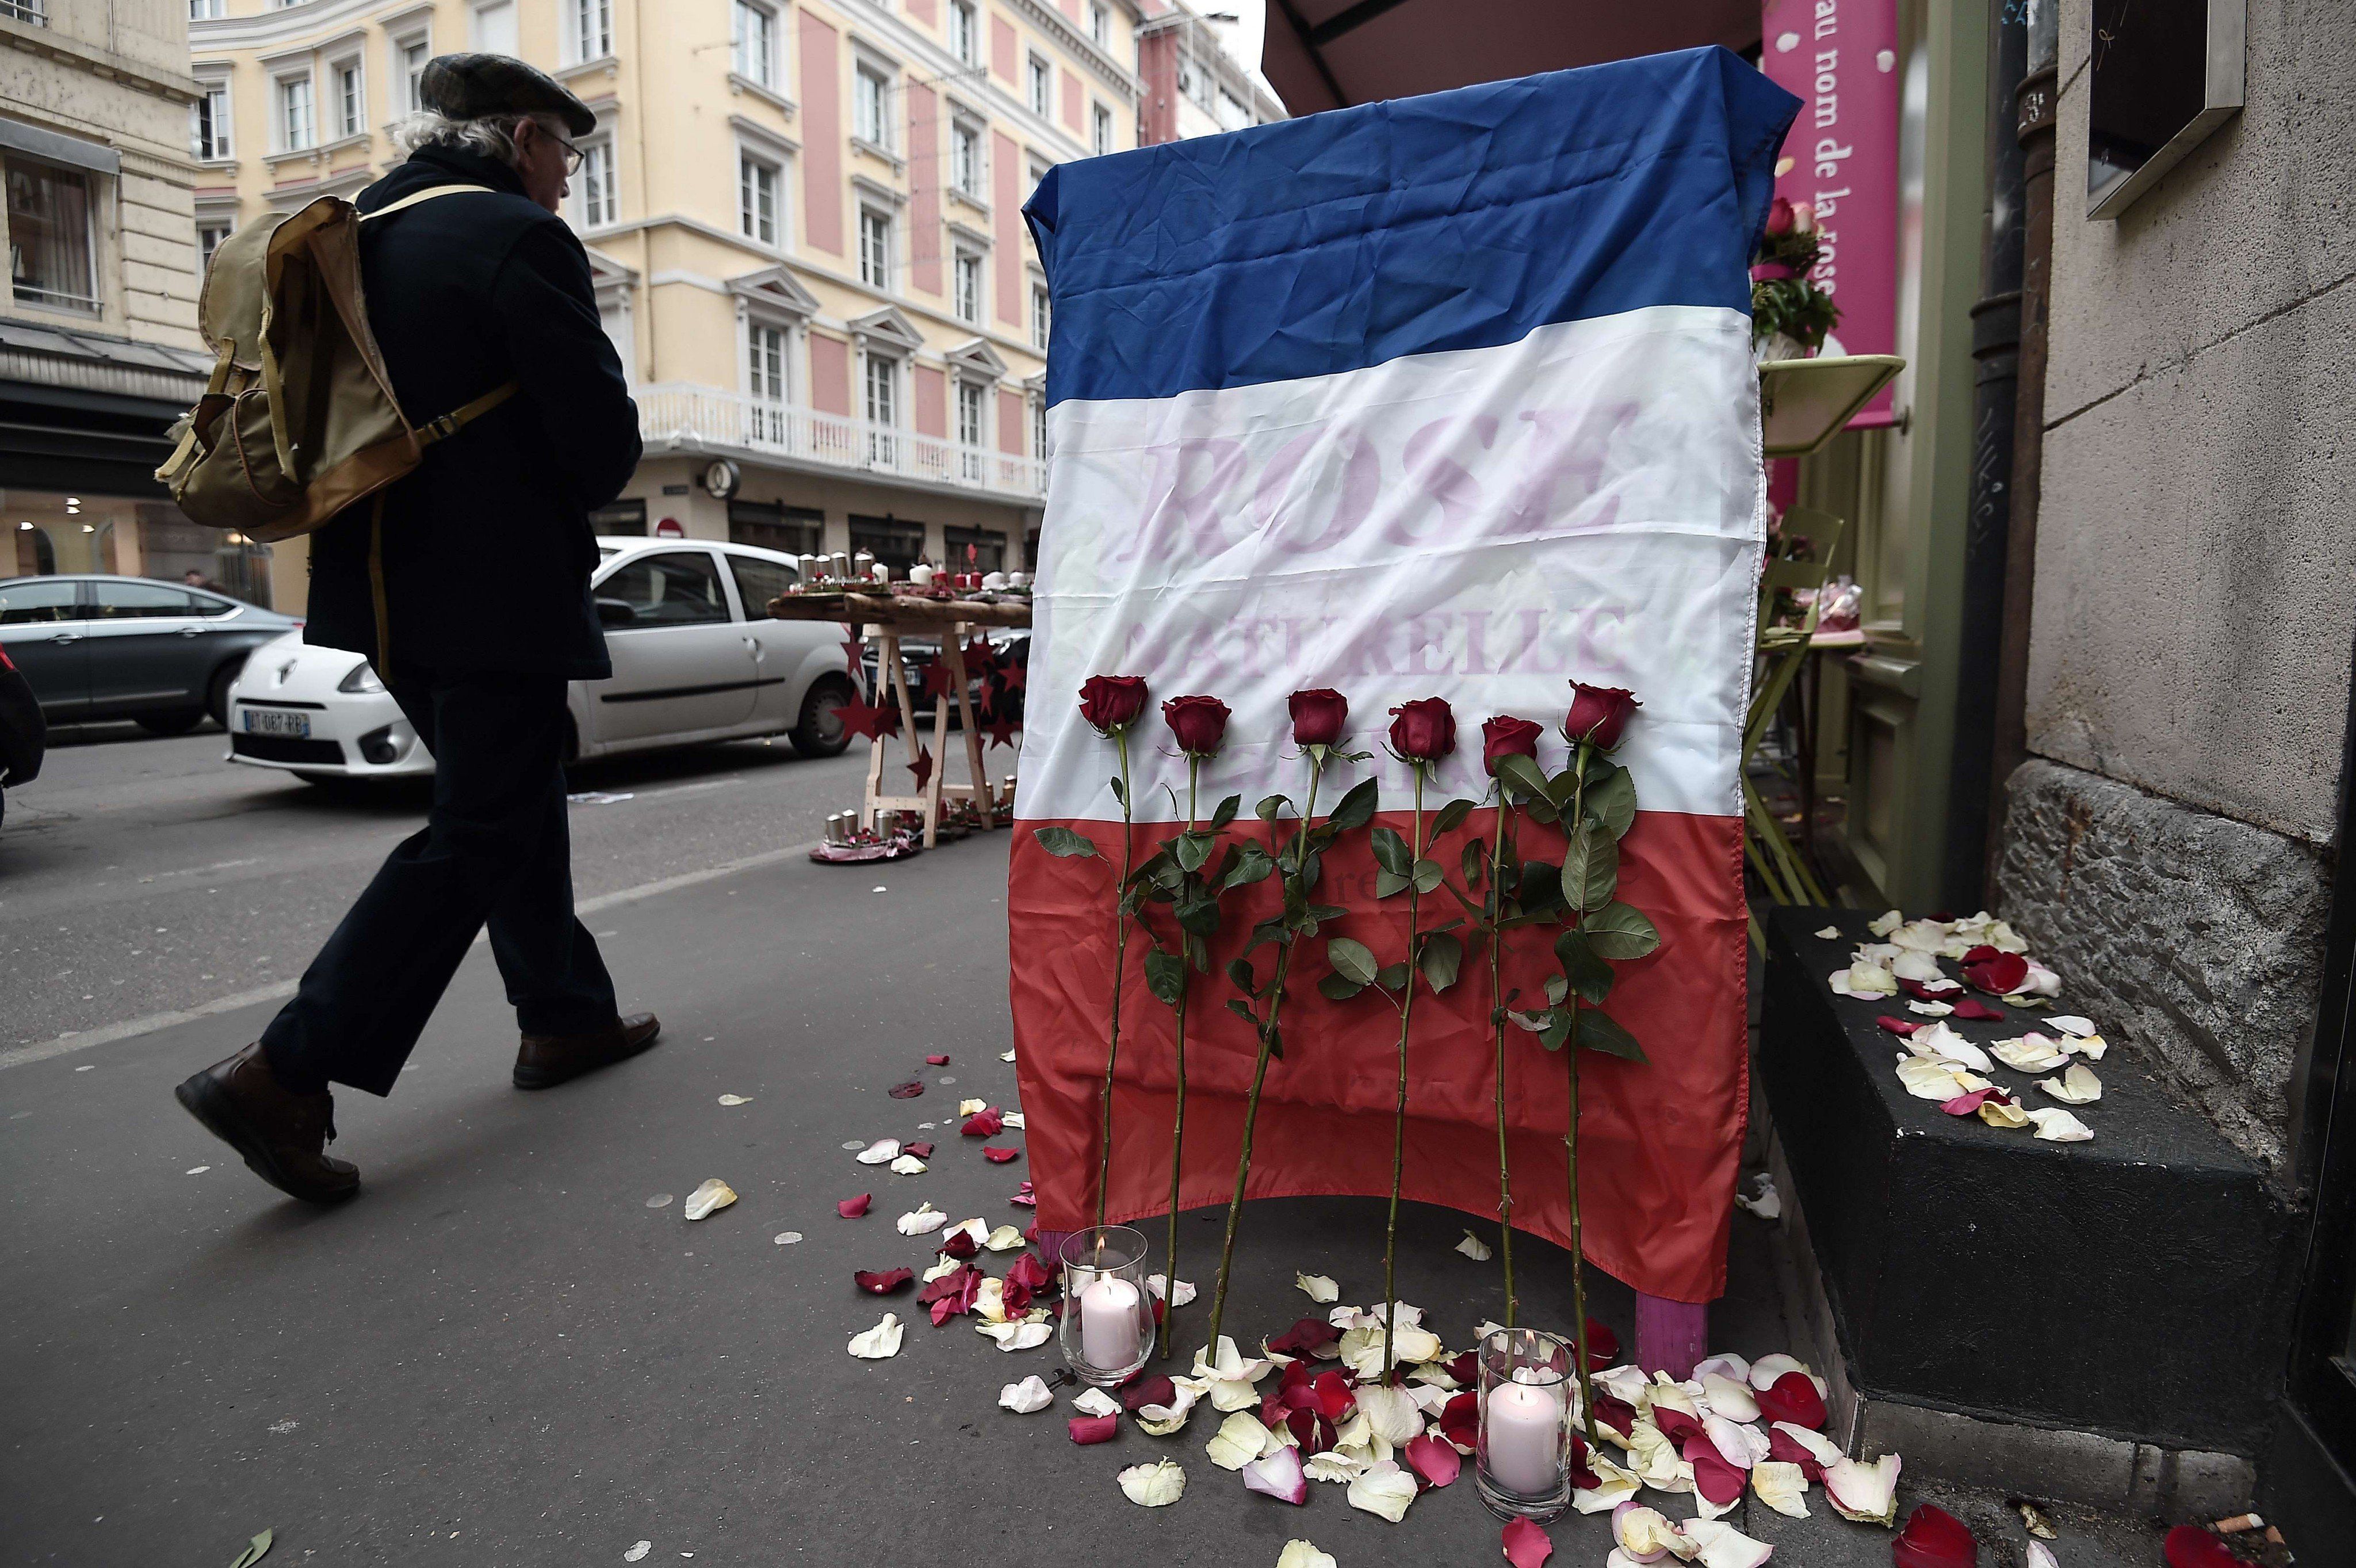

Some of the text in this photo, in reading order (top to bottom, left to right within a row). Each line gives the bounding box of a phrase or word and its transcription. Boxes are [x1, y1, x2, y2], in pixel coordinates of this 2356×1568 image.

[1814, 0, 1837, 41] au
[1815, 49, 1838, 128] nom
[1814, 138, 1853, 179] de
[1814, 187, 1852, 219] la
[1116, 401, 1640, 562] ROSE
